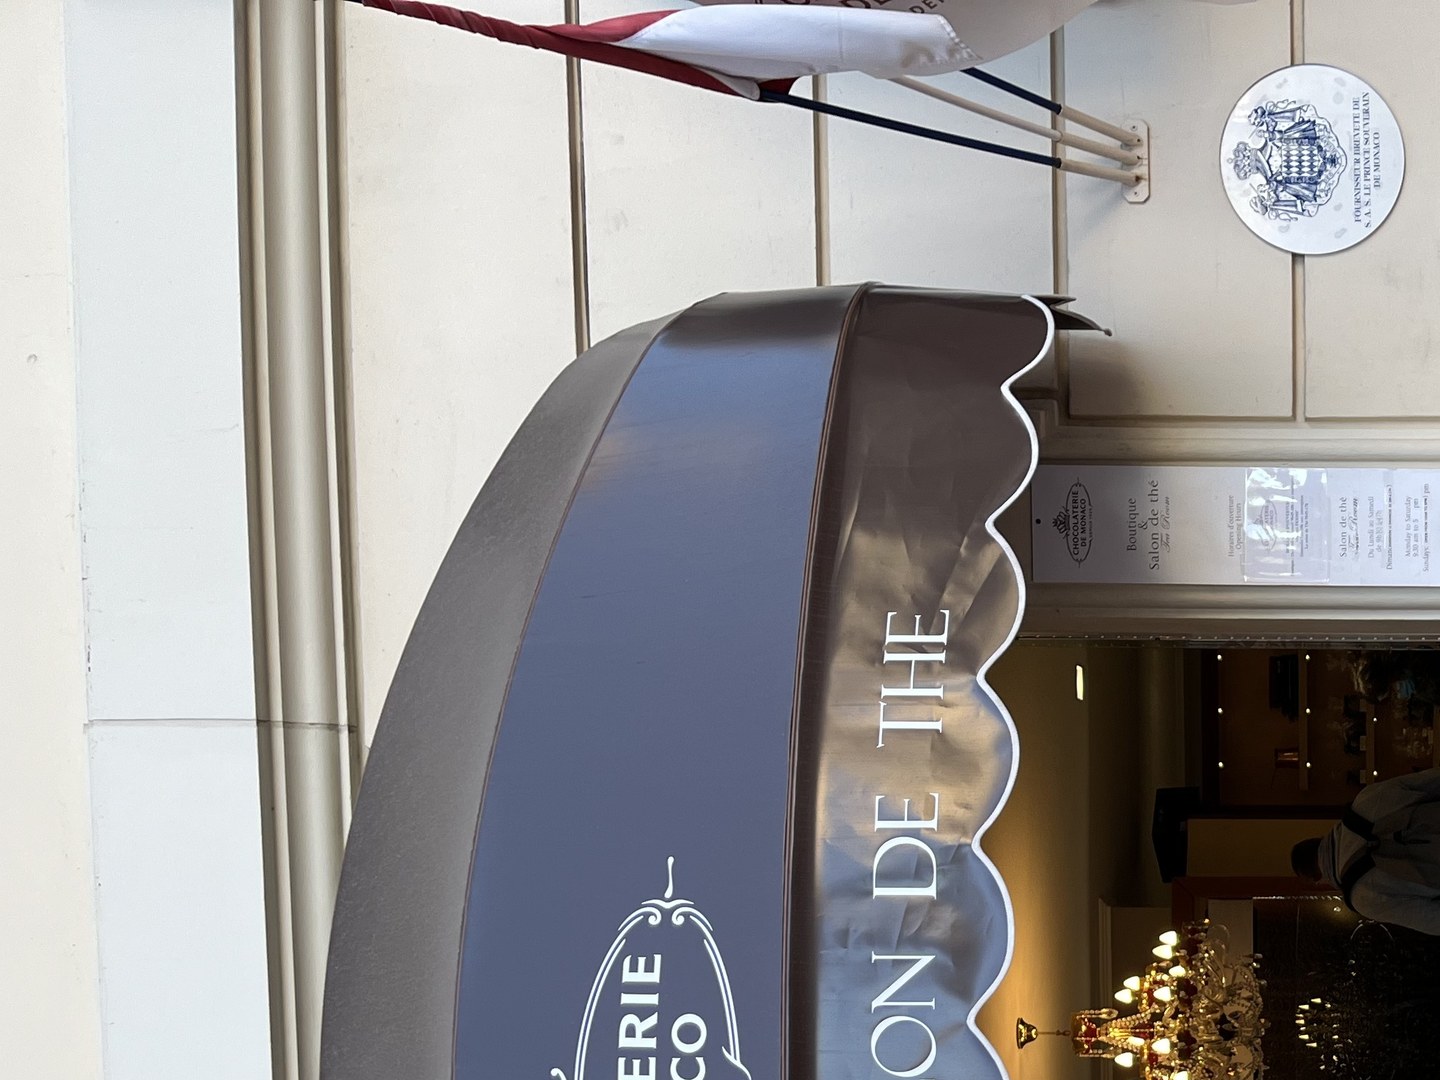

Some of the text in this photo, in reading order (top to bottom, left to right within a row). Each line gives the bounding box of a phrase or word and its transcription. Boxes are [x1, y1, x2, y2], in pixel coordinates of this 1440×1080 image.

[1353, 97, 1362, 222] FOURNISSEUR BREVETE DE
[1362, 92, 1371, 228] S. A. S. LE PRINCE SOUVERAIN
[1373, 174, 1381, 188] DE
[1072, 490, 1080, 556] CHOCOLATERIE
[1404, 496, 1412, 522] Saturday
[1413, 498, 1420, 509] pm
[1080, 537, 1087, 547] DE
[1126, 497, 1139, 551] Boutique
[1137, 520, 1148, 530] &
[1147, 480, 1160, 570] Salon de thé
[1160, 496, 1170, 553] Tea Room
[1235, 523, 1243, 550] Opening
[1338, 496, 1347, 557] Salon de thé
[1413, 533, 1419, 542] am
[1368, 548, 1374, 558] Du
[1404, 532, 1412, 557] Monday
[876, 609, 950, 749] THE
[872, 792, 940, 900] DE
